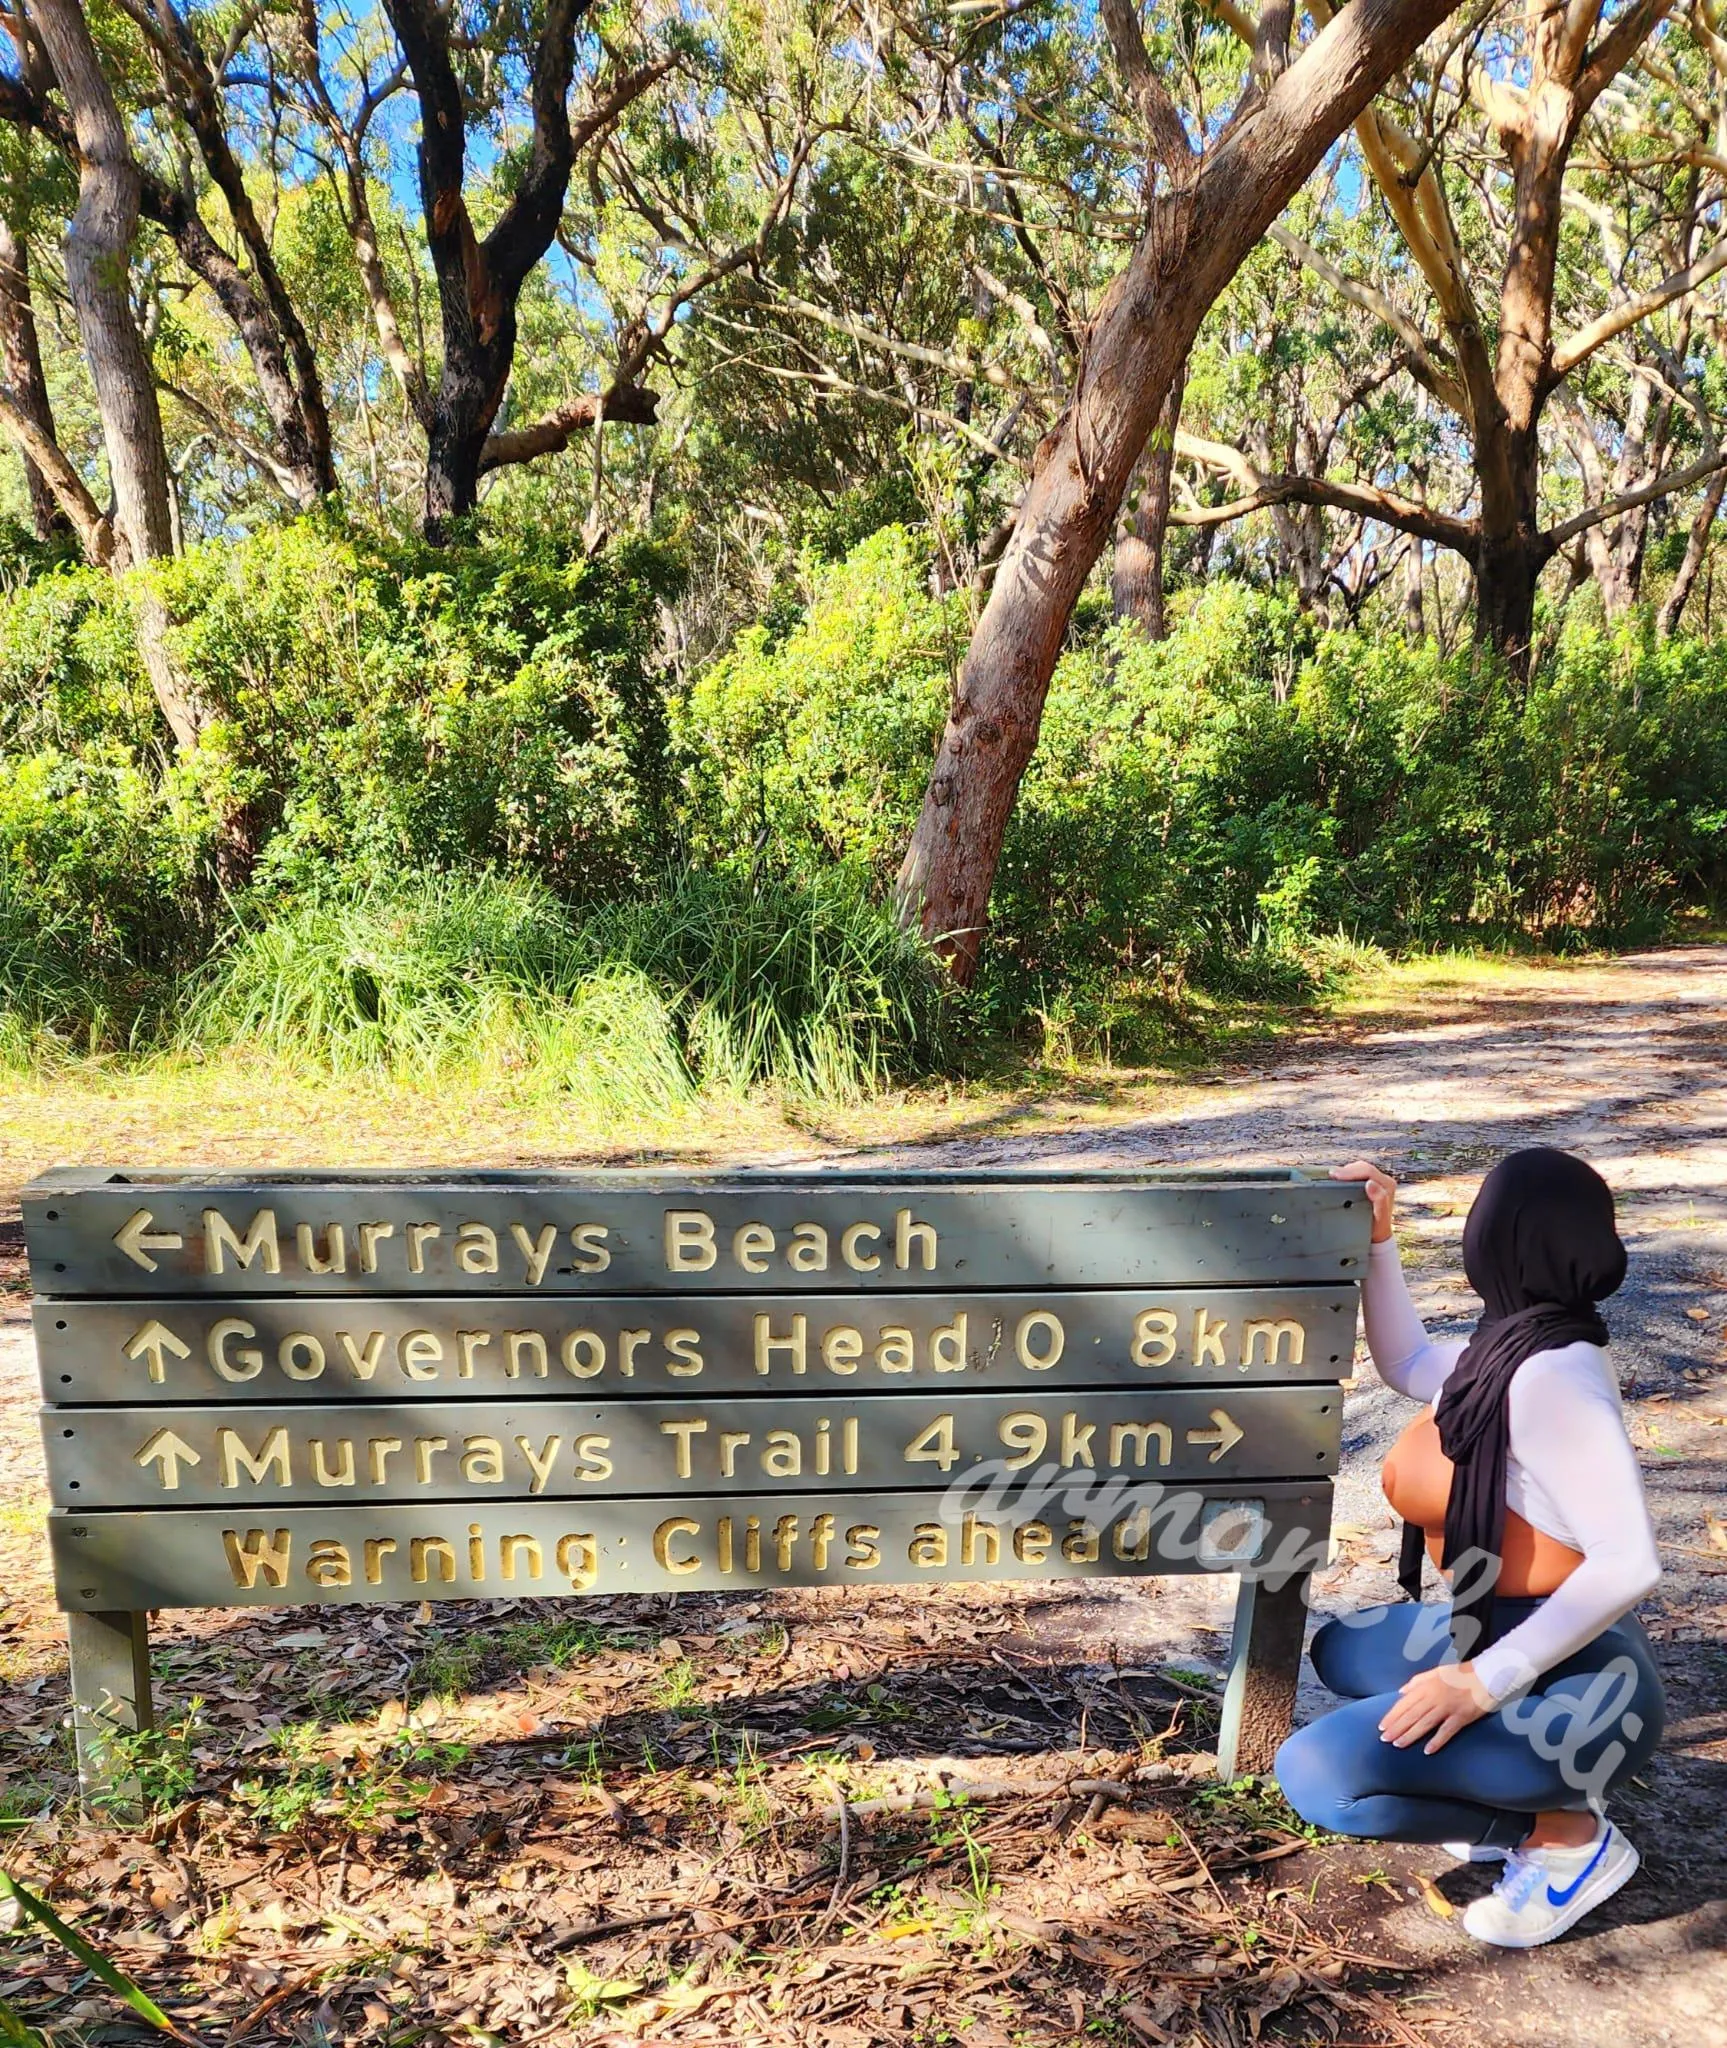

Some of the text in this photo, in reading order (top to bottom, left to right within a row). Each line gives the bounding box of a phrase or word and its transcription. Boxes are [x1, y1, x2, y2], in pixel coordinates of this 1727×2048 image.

[201, 1207, 938, 1286] Murrays Beach
[207, 1316, 704, 1383] Governors
[753, 1310, 968, 1376] Head
[215, 1425, 613, 1494] Murrays
[660, 1416, 859, 1479] Trail
[653, 1513, 881, 1575] Cliffs
[907, 1508, 1151, 1569] ahead
